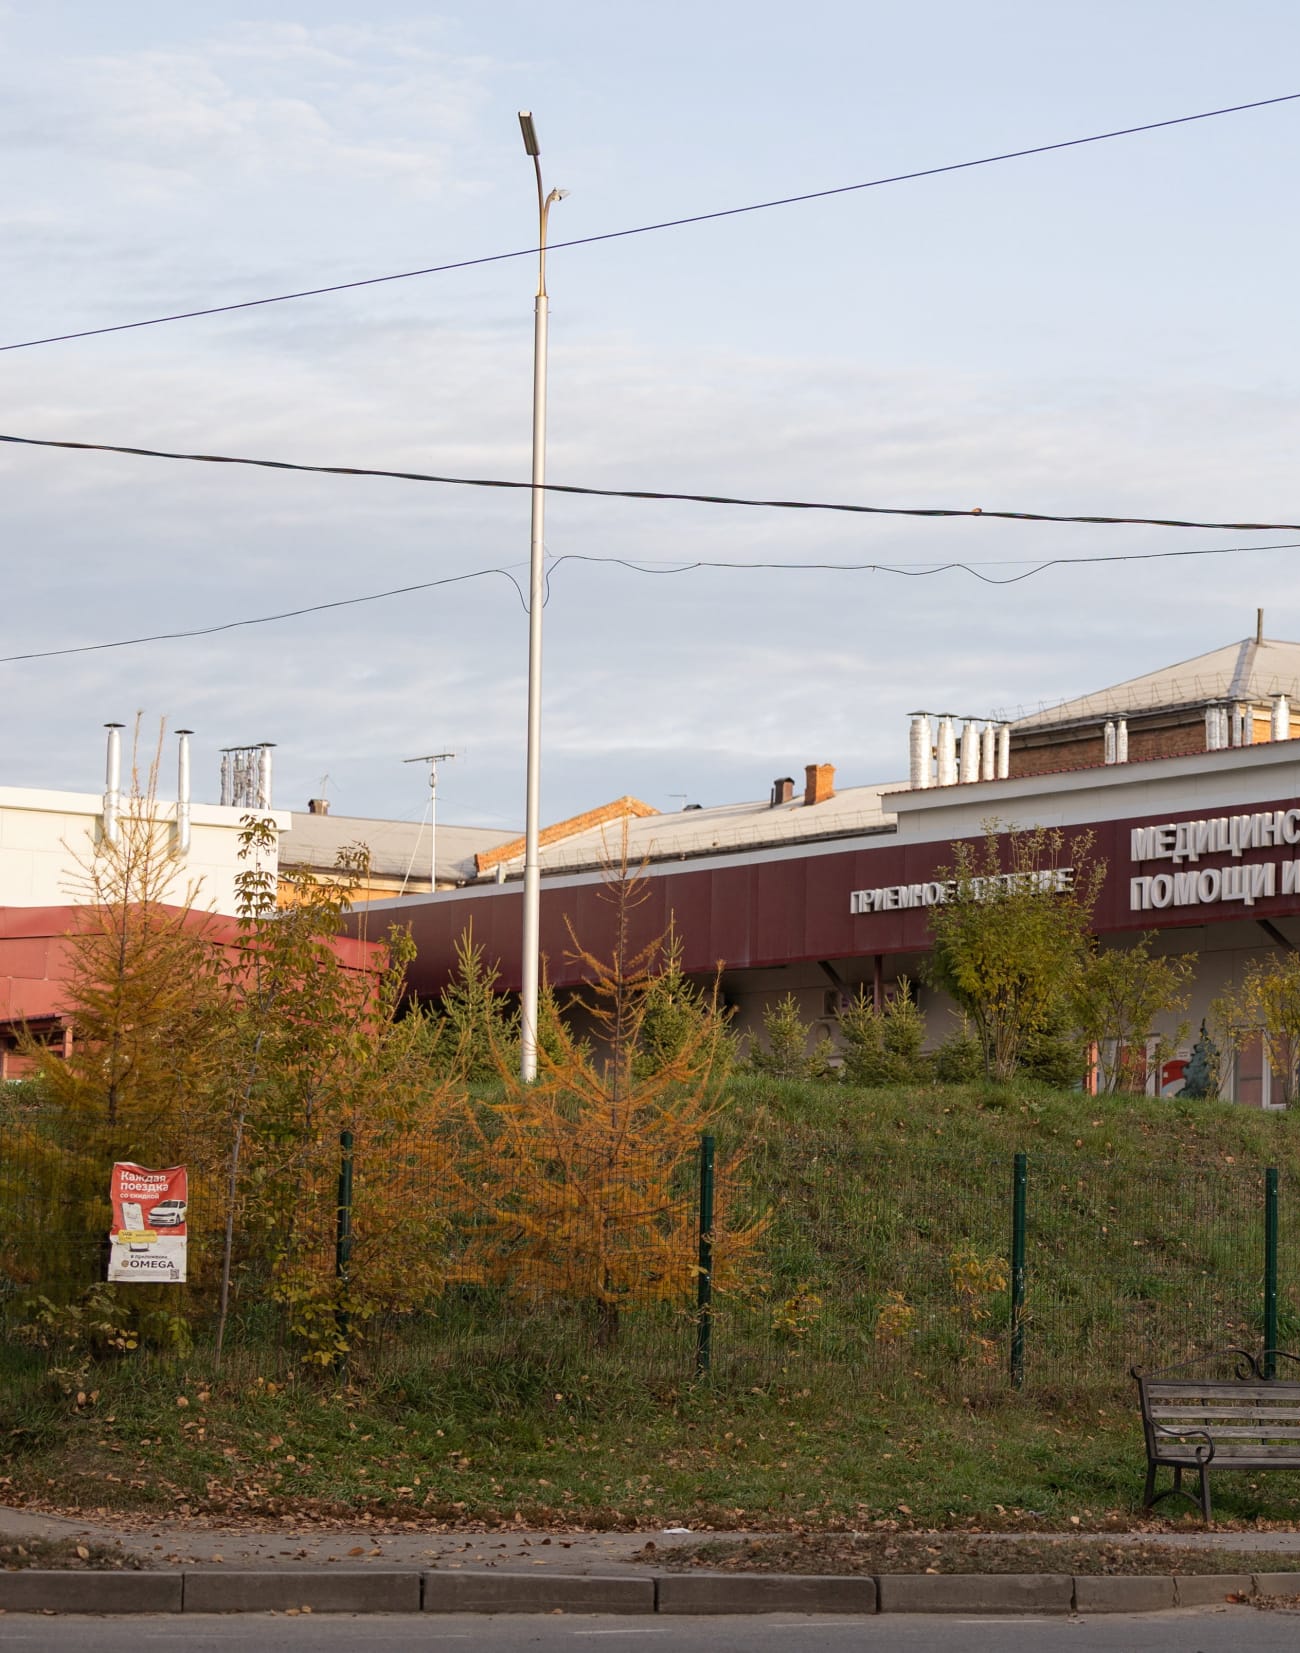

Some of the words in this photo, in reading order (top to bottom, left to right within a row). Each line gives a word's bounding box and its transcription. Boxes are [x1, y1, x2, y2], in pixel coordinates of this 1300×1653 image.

[1130, 862, 1276, 911] ПОМОЩИ
[850, 880, 957, 914] ПРИЕМНОЕ
[121, 1171, 166, 1183] Каждая
[121, 1182, 168, 1192] поездка
[130, 1260, 175, 1269] OMEGA
